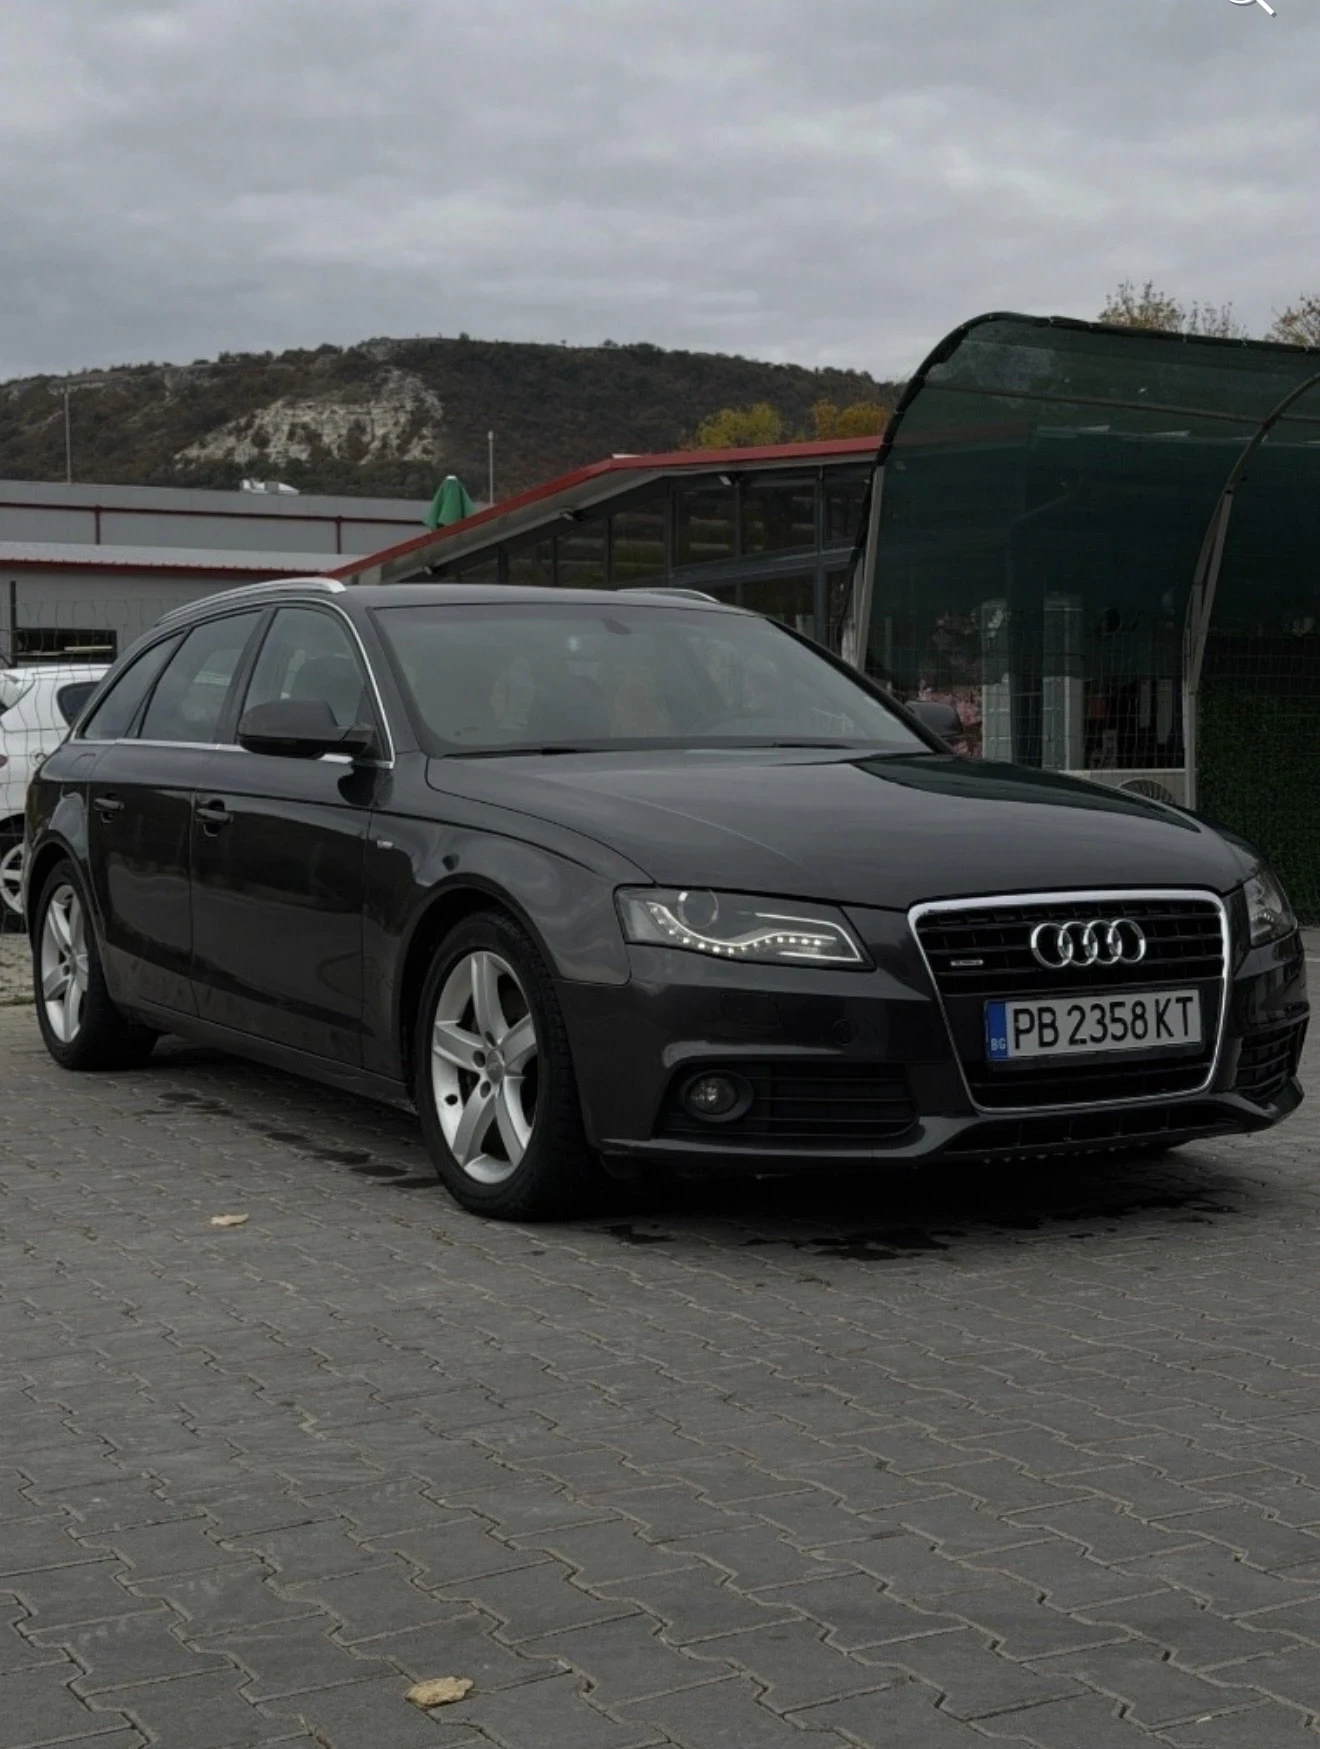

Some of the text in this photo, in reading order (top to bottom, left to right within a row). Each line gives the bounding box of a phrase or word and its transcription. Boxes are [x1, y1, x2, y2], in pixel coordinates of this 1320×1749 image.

[1013, 996, 1193, 1049] PB 2358 KT
[990, 1039, 1006, 1051] BG
